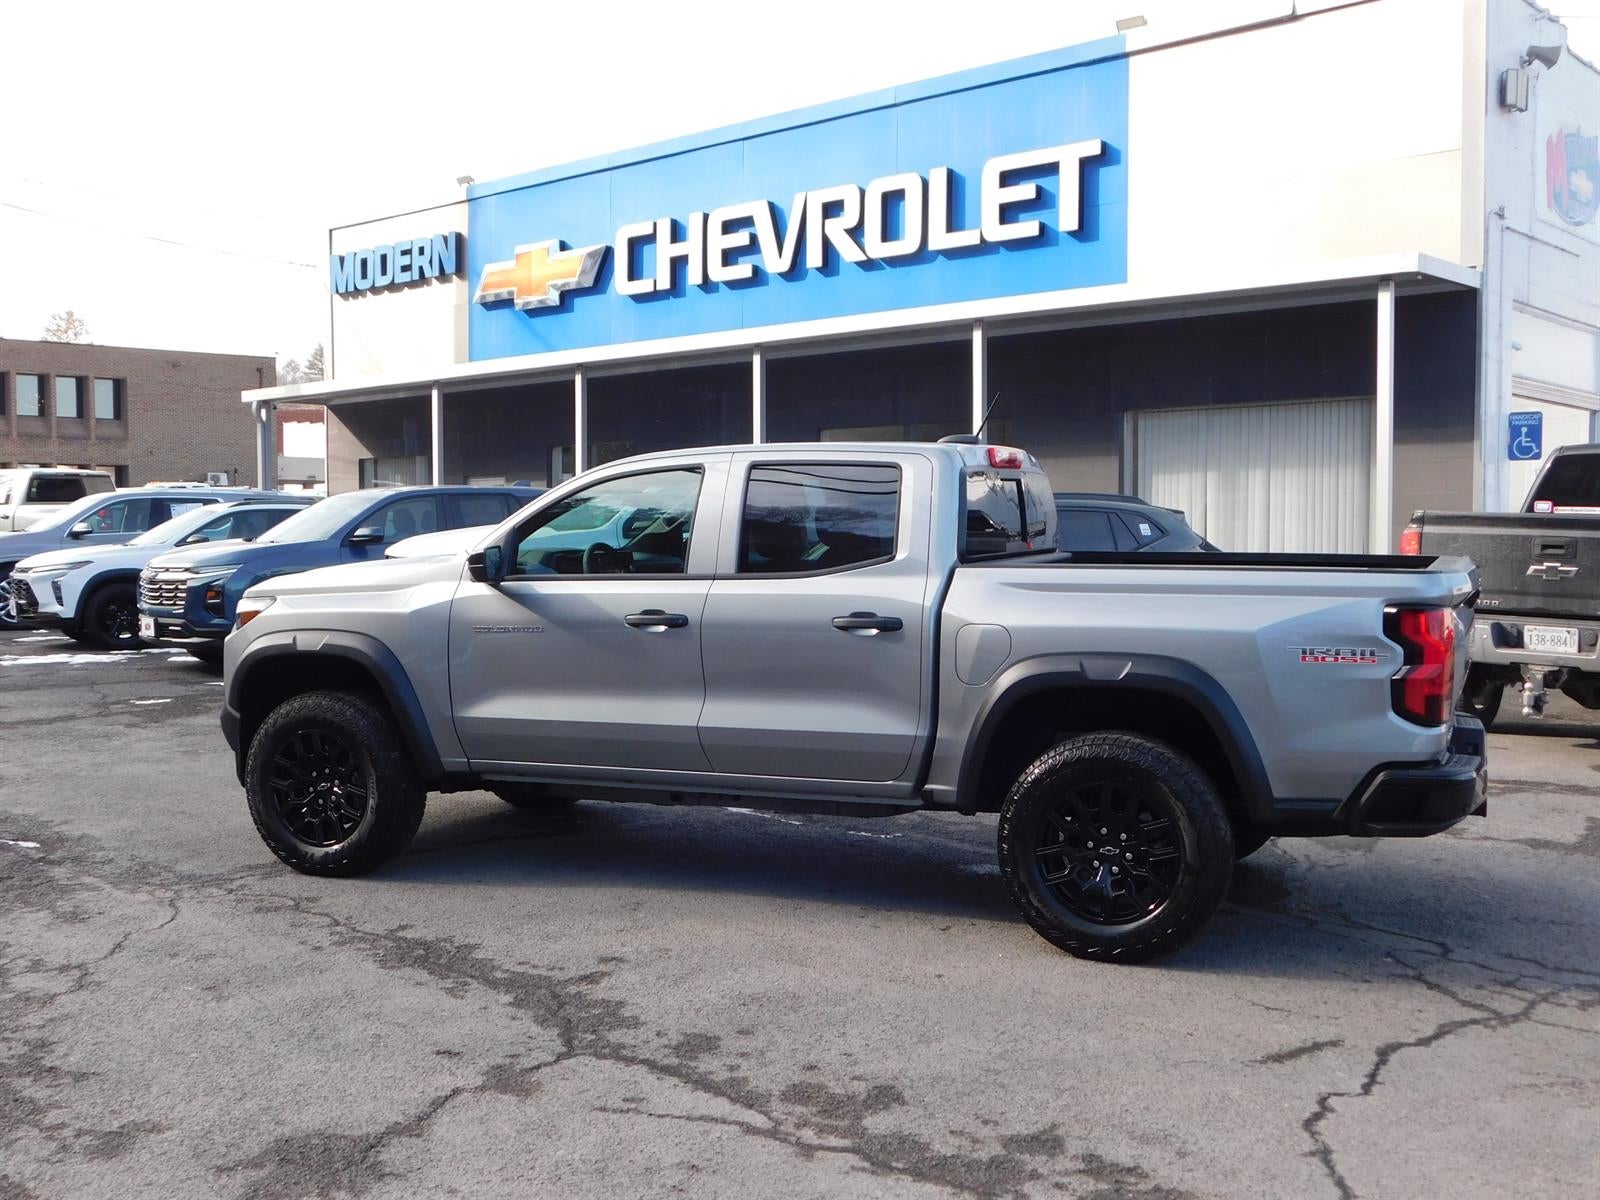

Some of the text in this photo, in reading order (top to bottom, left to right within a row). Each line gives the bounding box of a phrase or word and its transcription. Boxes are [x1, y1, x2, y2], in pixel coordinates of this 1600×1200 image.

[614, 138, 1104, 297] CHEVROLET
[330, 231, 459, 295] MODERN
[1510, 413, 1542, 421] HANDICAP
[1288, 647, 1388, 657] TRAIL
[1301, 655, 1377, 664] BOSS
